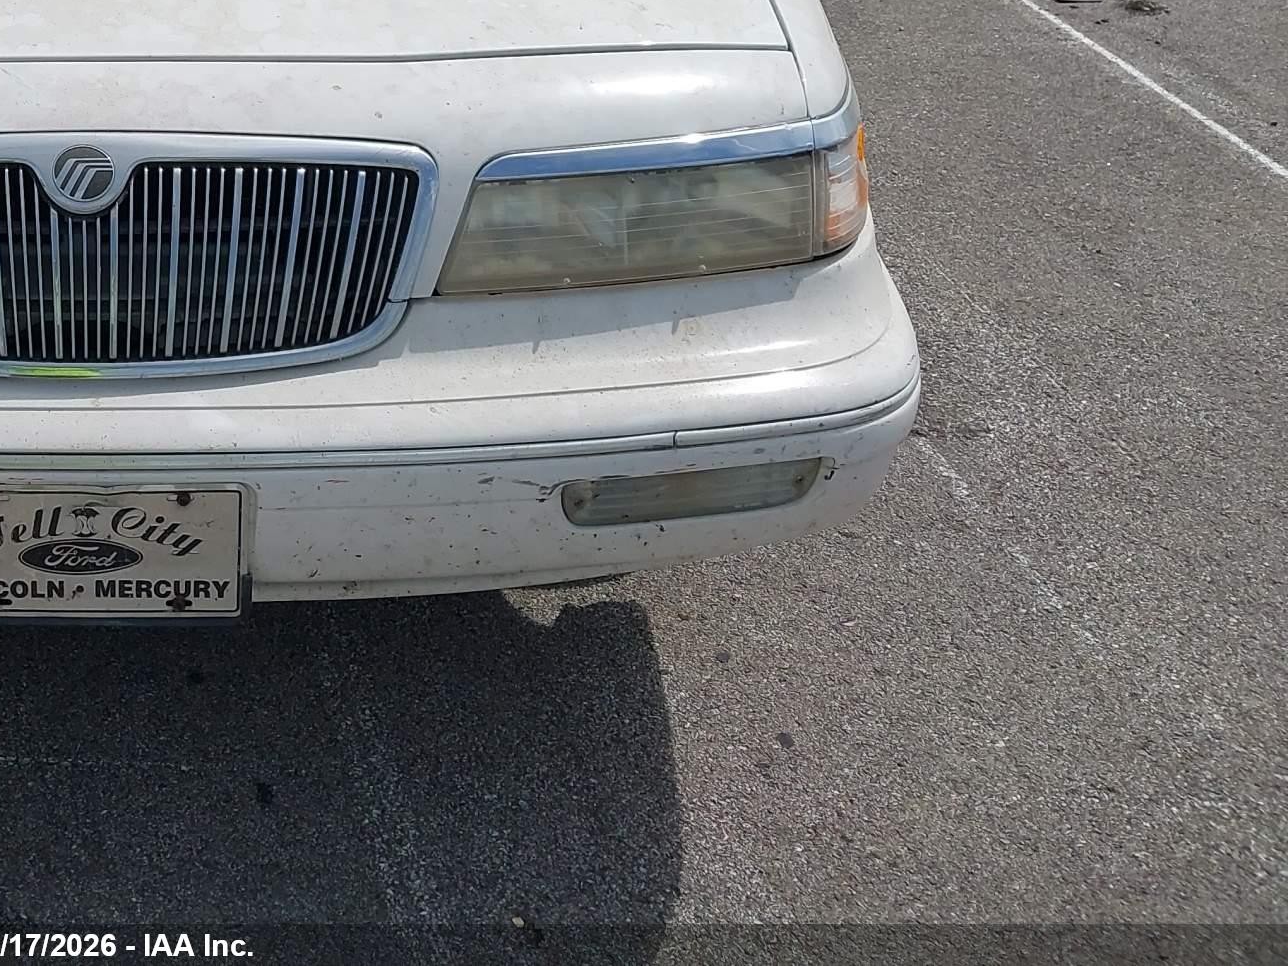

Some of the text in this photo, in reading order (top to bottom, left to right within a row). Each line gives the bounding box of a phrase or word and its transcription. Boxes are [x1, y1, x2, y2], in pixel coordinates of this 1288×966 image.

[111, 506, 205, 556] City
[44, 544, 117, 568] Ford
[95, 580, 230, 599] MERCURY
